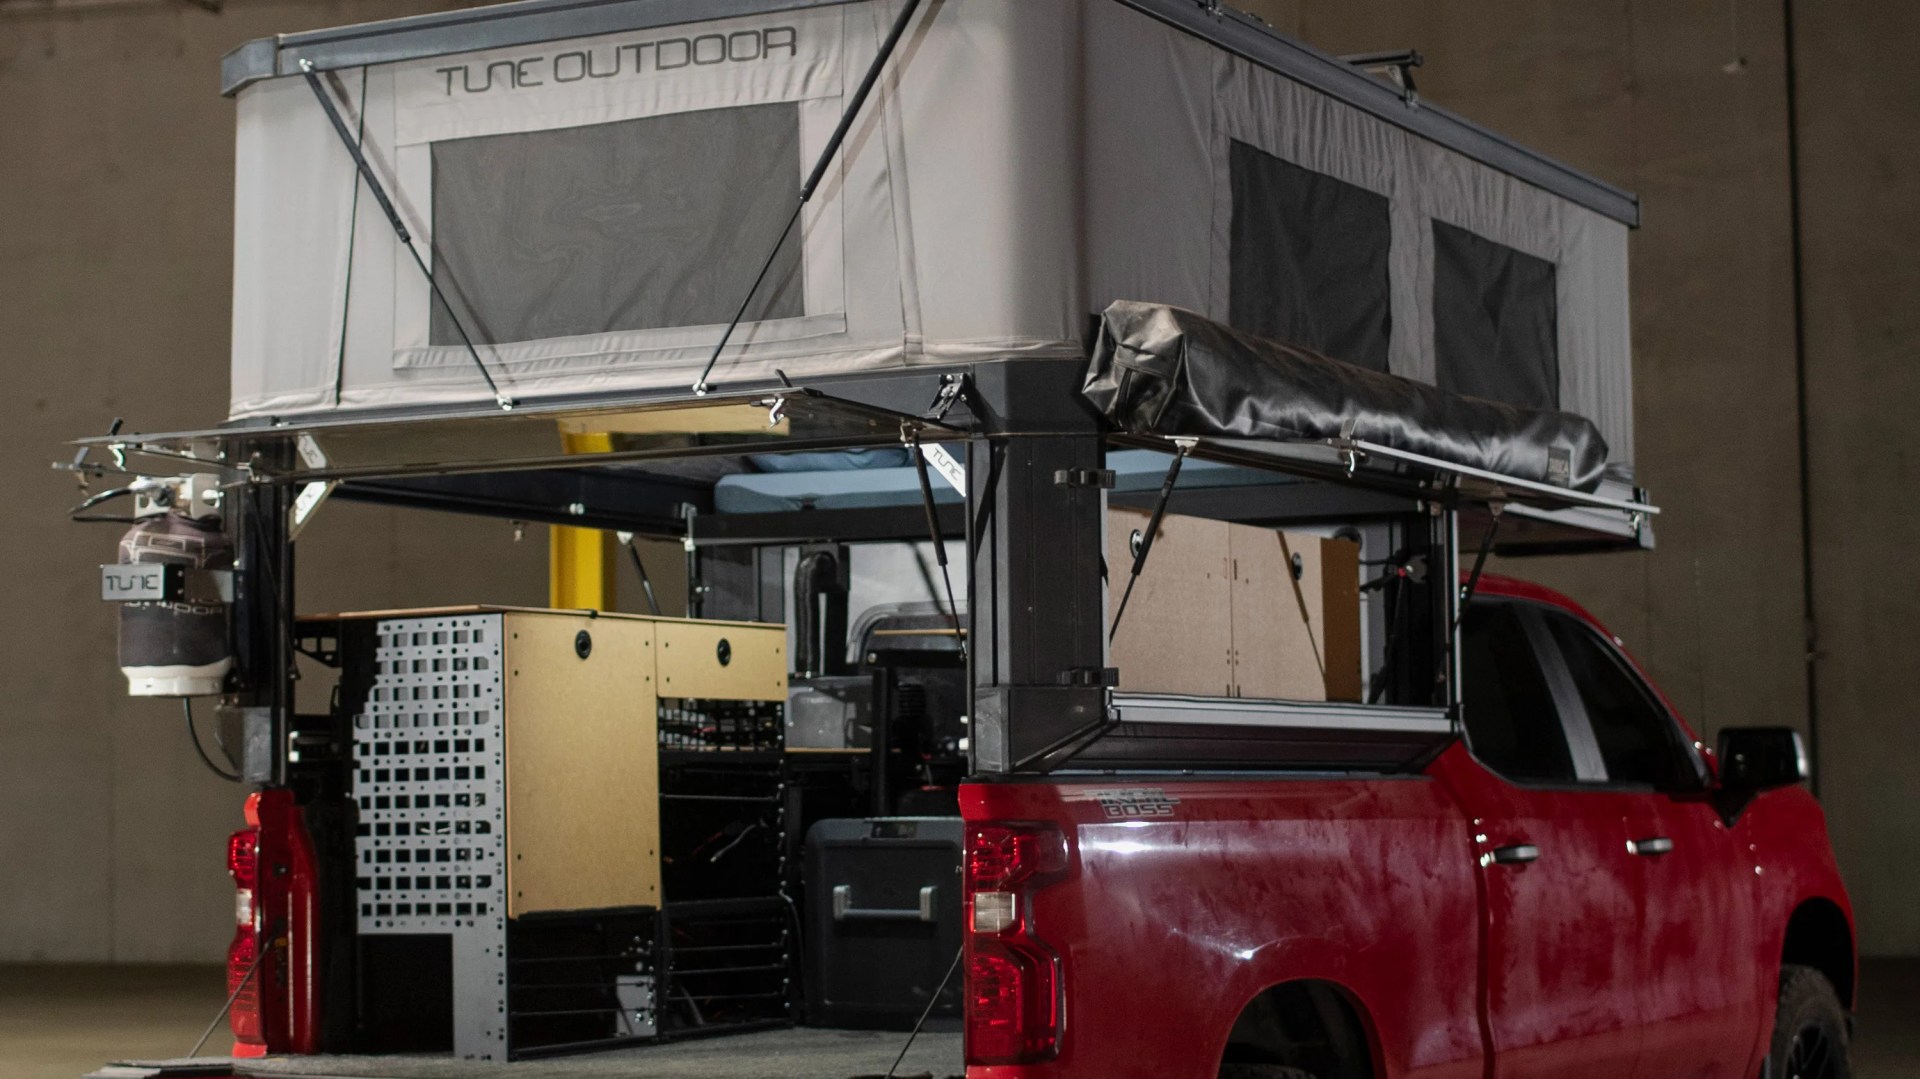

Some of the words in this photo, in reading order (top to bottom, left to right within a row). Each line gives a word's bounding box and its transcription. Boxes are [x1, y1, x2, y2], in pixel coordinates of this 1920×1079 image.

[436, 57, 544, 96] TUNE
[553, 26, 798, 83] OUTDOOR
[932, 447, 962, 481] TUNE
[105, 574, 159, 591] TUNE
[1102, 803, 1175, 819] BOSS
